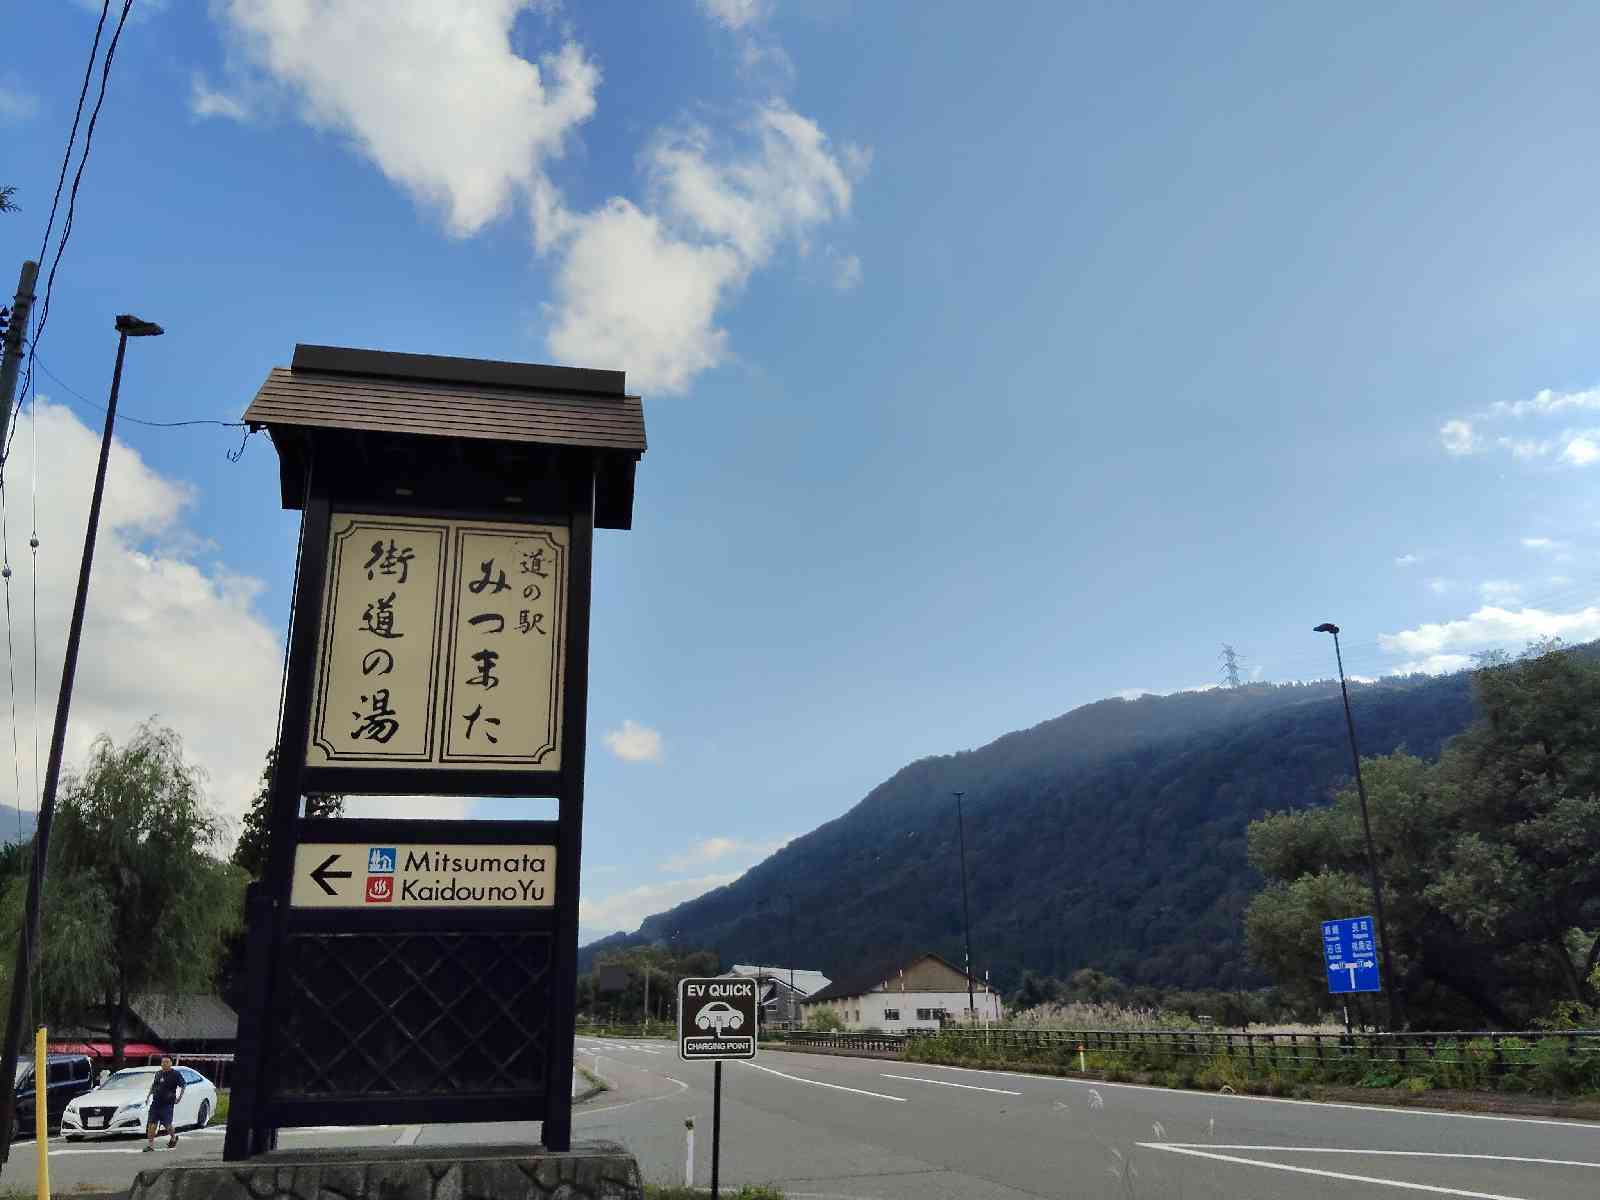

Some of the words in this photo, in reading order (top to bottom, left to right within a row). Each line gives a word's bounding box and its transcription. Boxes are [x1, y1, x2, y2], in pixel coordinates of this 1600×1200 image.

[513, 548, 551, 635] 道の駅
[351, 539, 416, 743] 街道の湯
[463, 558, 512, 743] みつまた
[404, 851, 546, 873] Mitsumata
[401, 878, 545, 901] KaidounoYu
[687, 984, 706, 997] EV
[709, 984, 752, 997] QUICK
[687, 1042, 726, 1051] CHARGING
[727, 1042, 750, 1050] POINT
